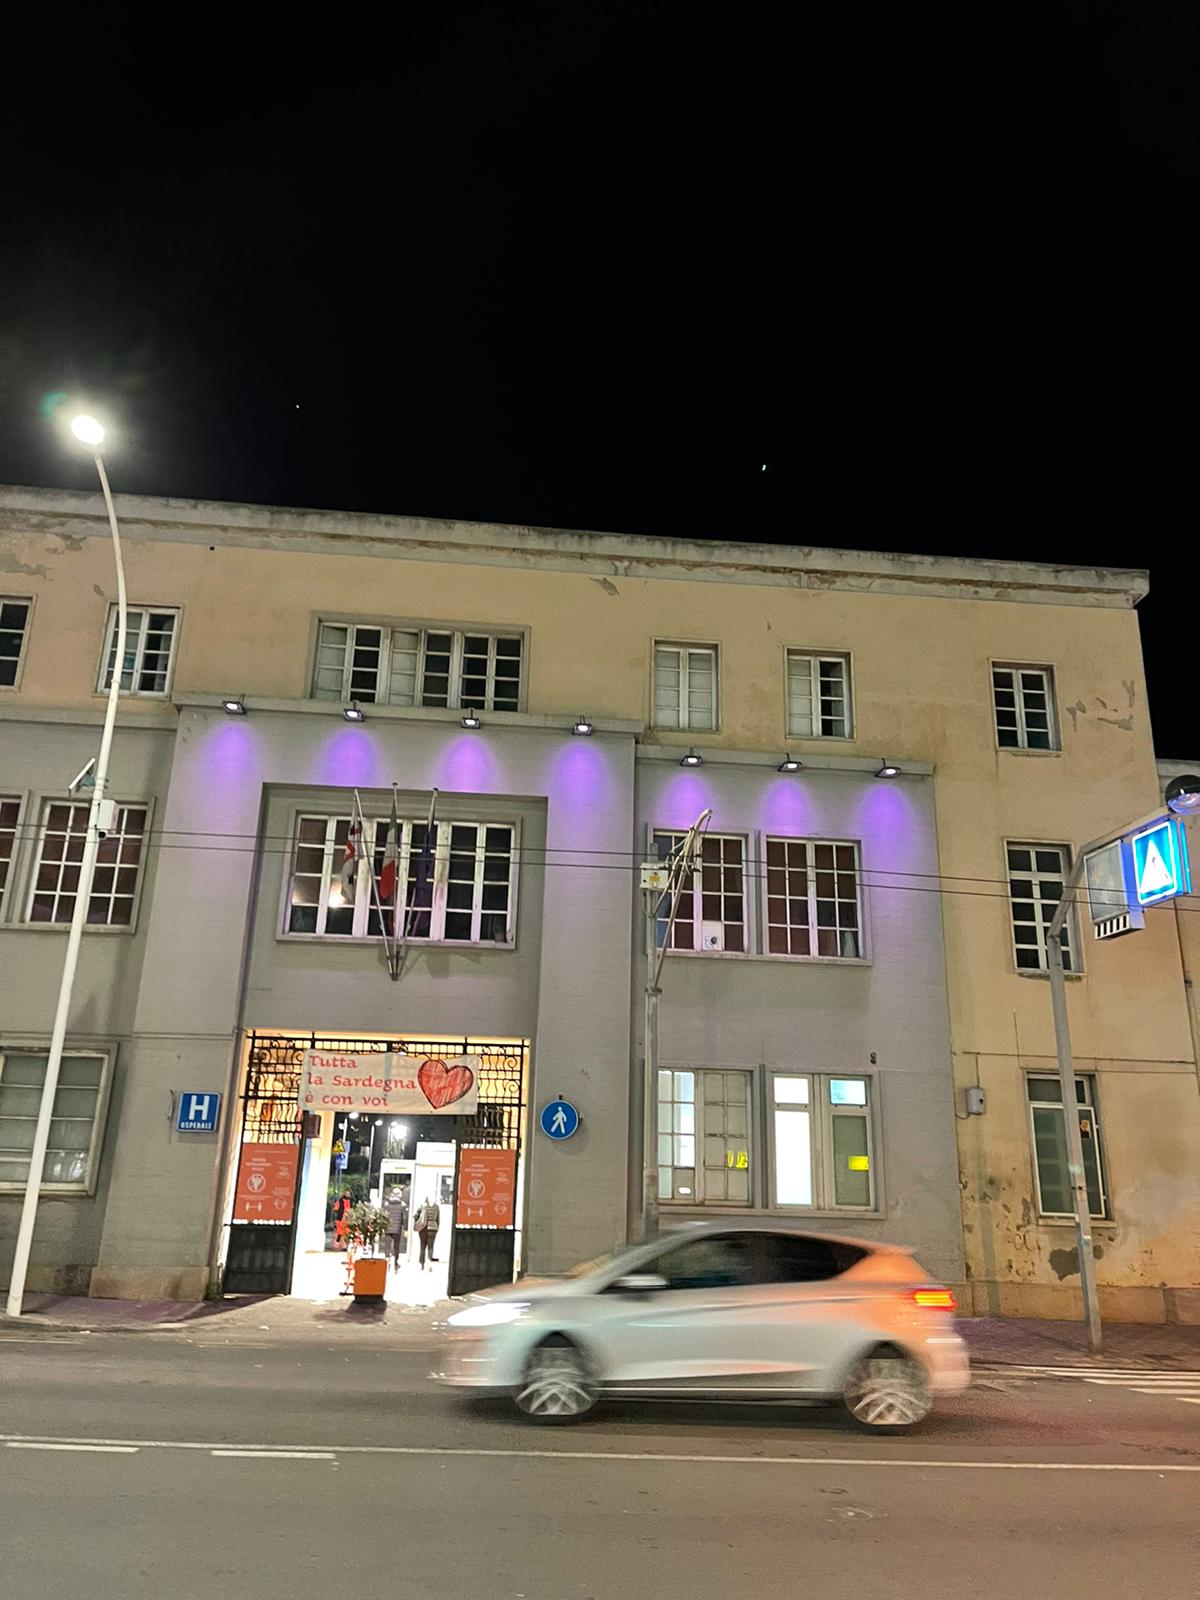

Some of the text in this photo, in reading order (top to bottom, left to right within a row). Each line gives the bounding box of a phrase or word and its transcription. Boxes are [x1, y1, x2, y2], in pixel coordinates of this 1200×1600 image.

[309, 1055, 357, 1069] Tutta
[307, 1072, 417, 1092] la Sardegna
[188, 1094, 210, 1121] H
[305, 1091, 390, 1107] è con voi
